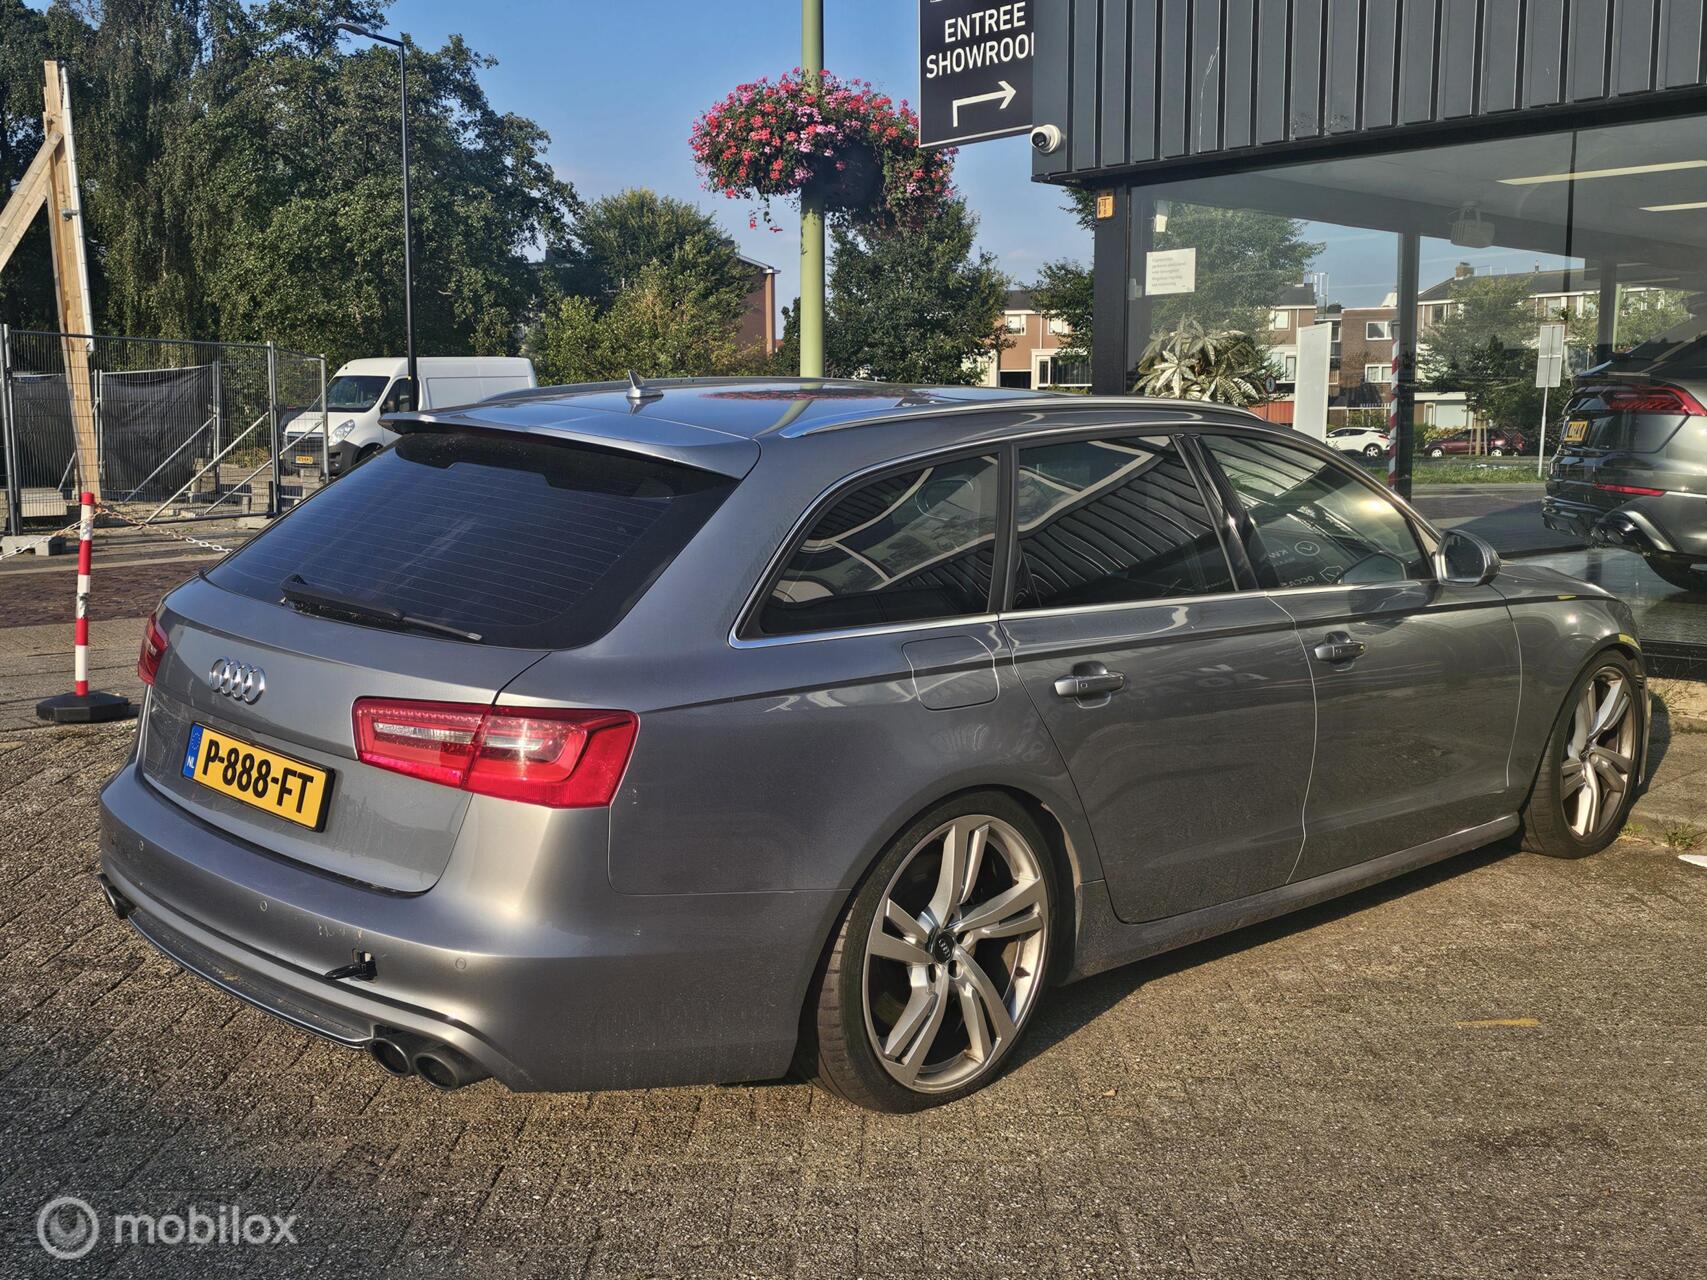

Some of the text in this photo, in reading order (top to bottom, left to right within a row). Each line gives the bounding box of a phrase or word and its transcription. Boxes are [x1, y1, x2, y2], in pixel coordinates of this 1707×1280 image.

[944, 1, 1026, 43] ENTREE
[926, 32, 1035, 79] SHOWROO
[186, 755, 195, 769] NL
[202, 739, 315, 814] P-888-FT
